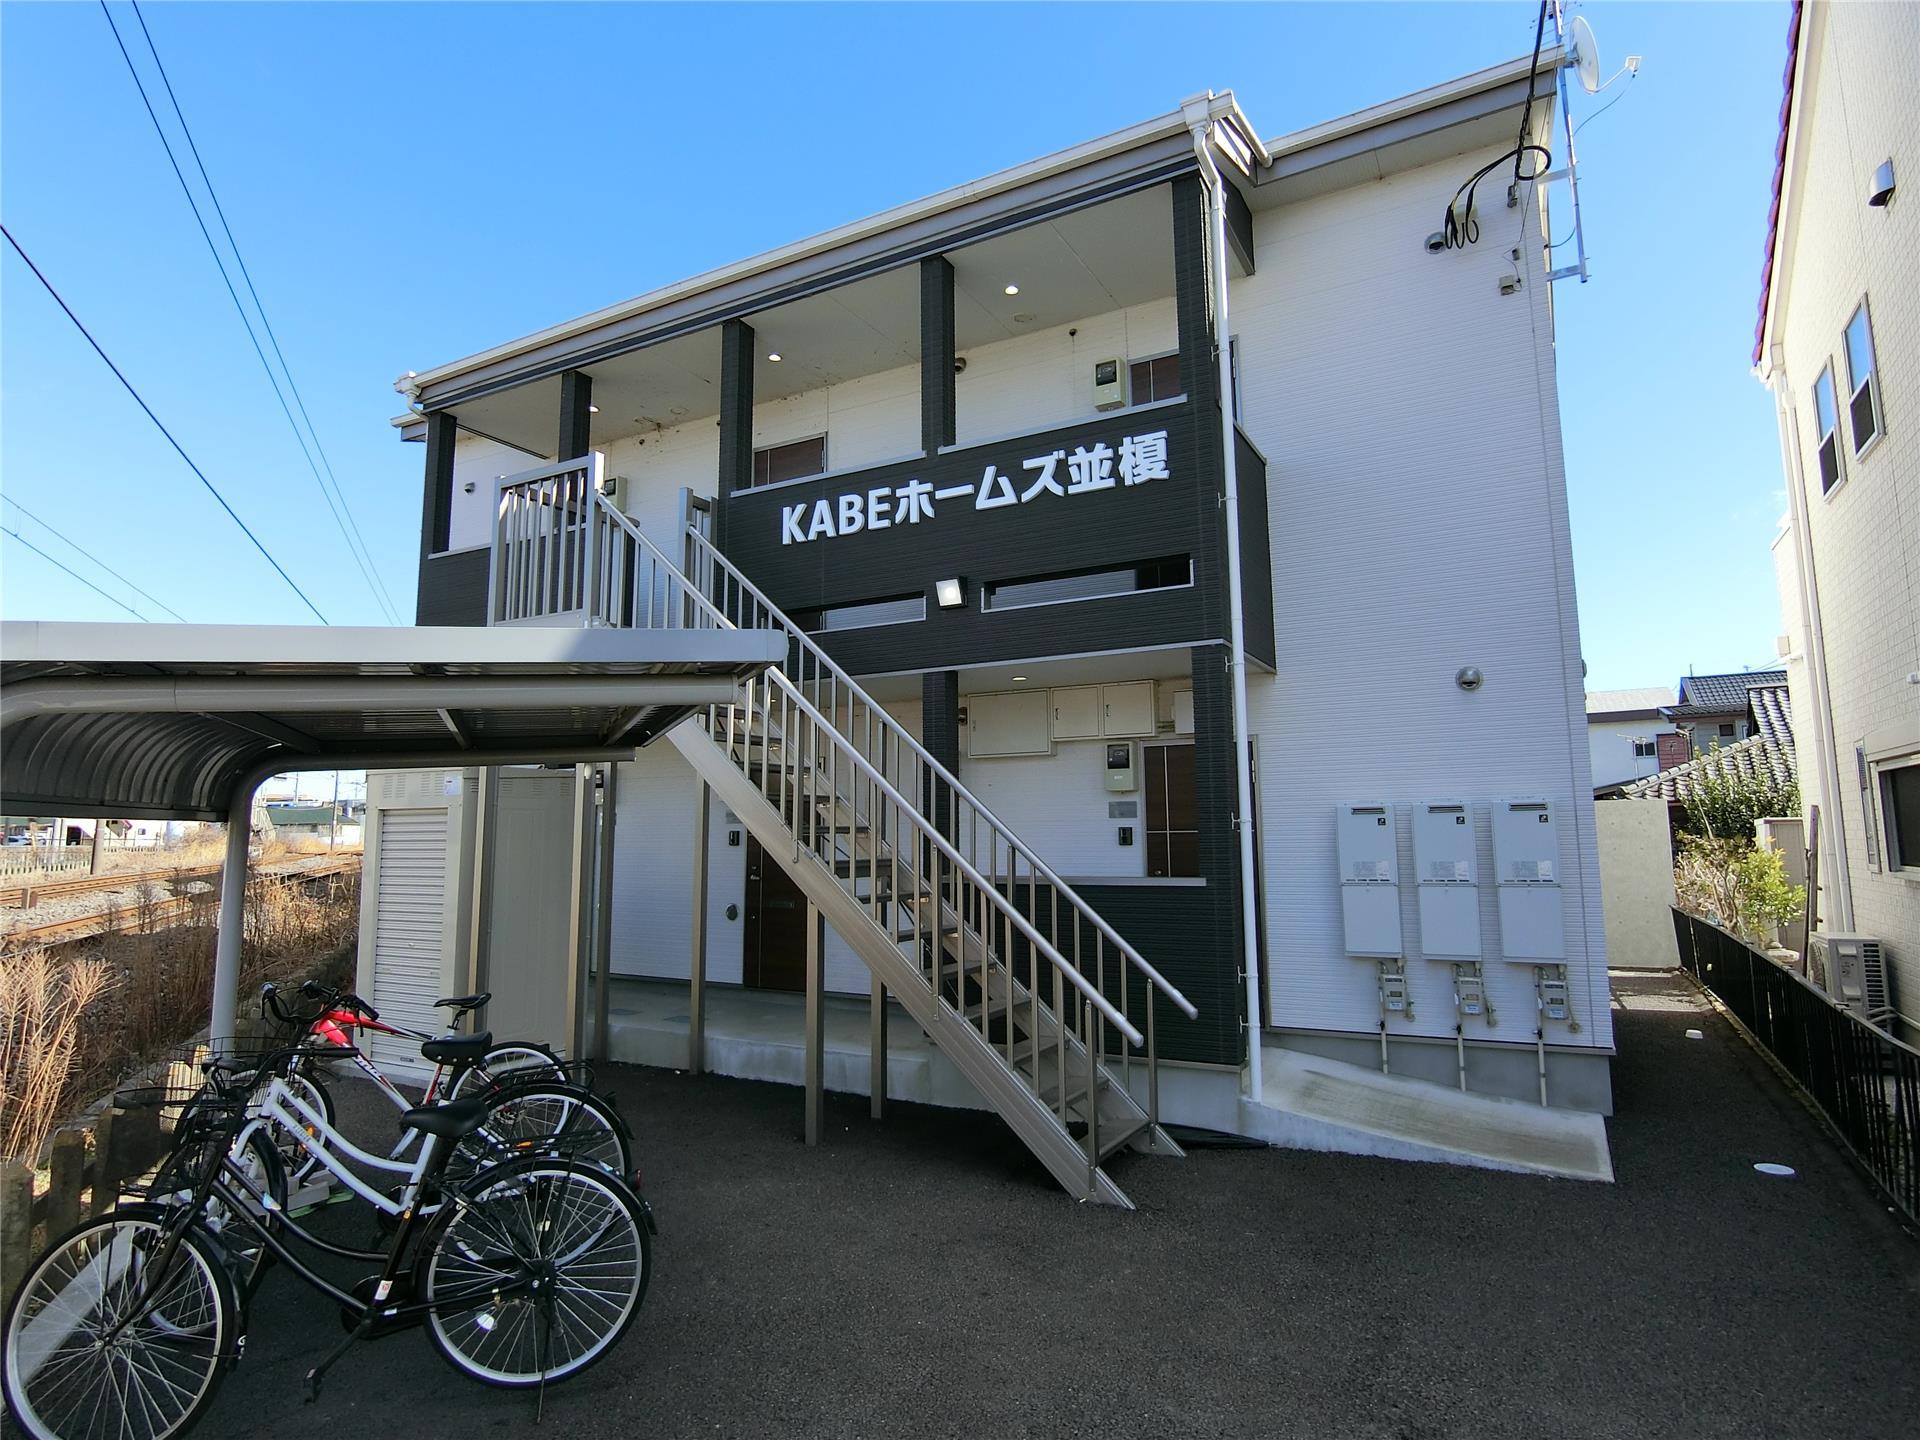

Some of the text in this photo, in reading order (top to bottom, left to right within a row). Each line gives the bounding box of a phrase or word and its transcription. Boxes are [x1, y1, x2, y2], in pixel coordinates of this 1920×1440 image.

[782, 430, 1170, 545] KABEホームズ並榎
